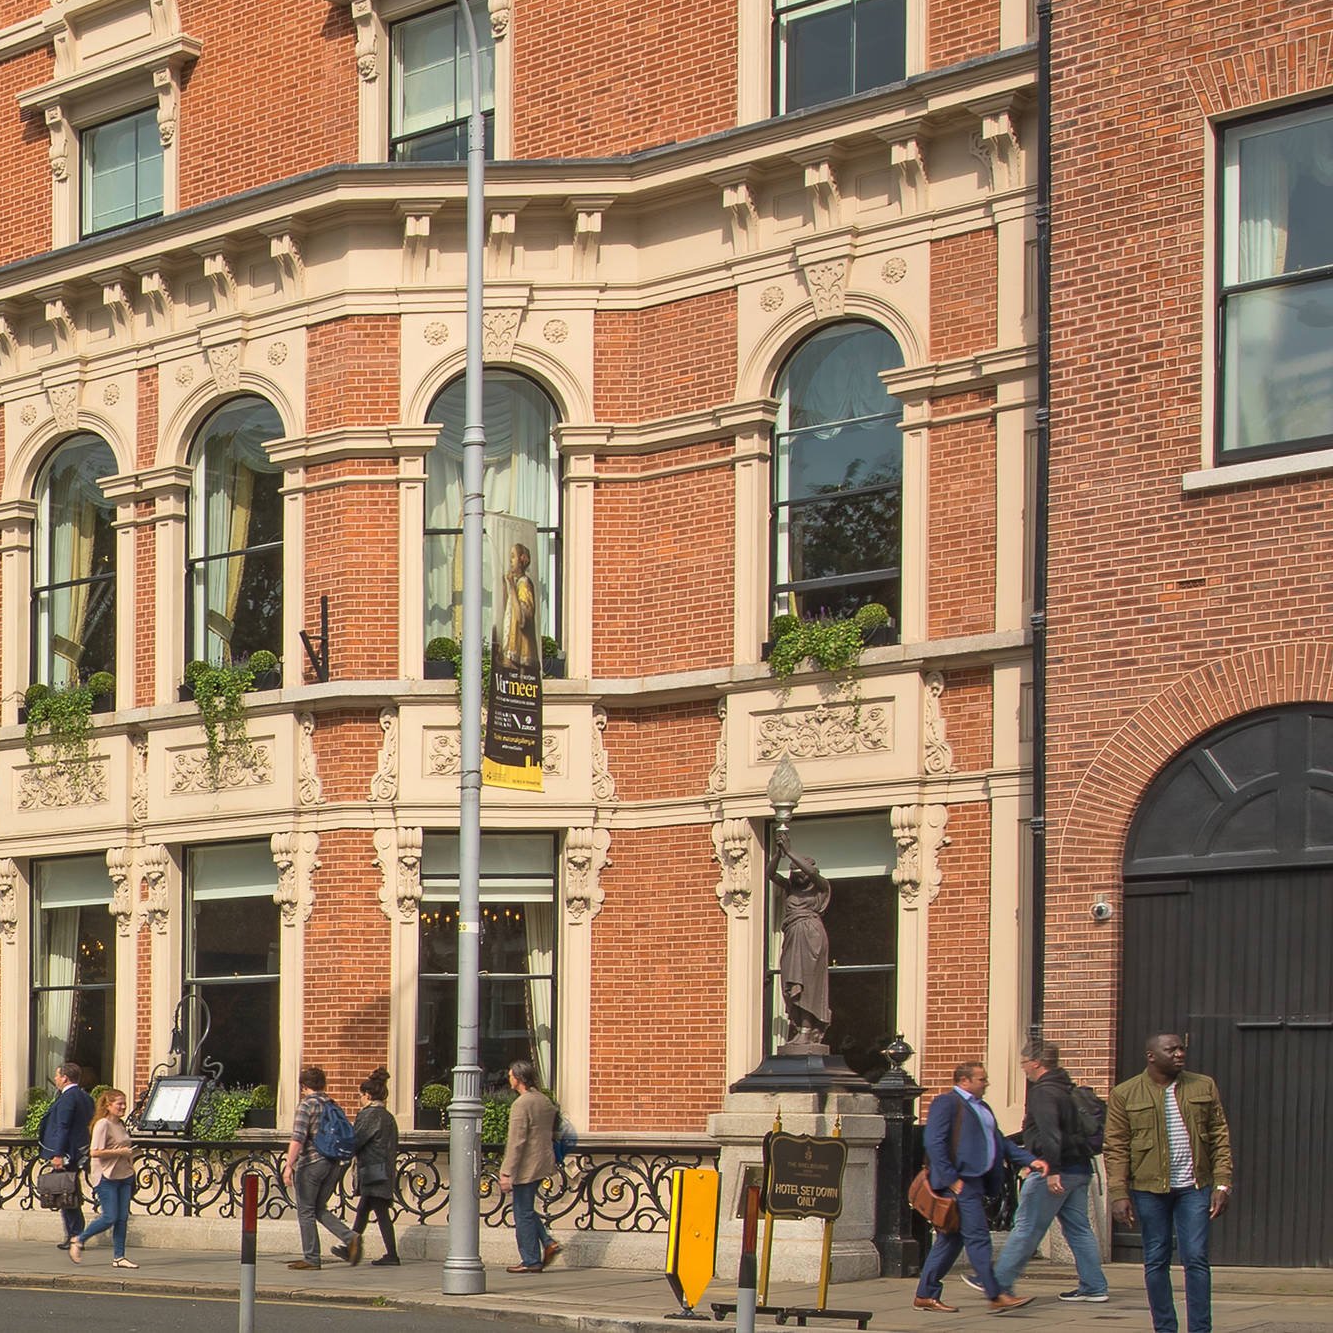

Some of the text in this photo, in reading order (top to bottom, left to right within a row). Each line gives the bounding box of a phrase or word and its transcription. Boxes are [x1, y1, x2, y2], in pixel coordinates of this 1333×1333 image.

[495, 672, 539, 698] Vermeer
[774, 1183, 838, 1199] HOTEL SET DOWN
[797, 1195, 817, 1207] ONLY
